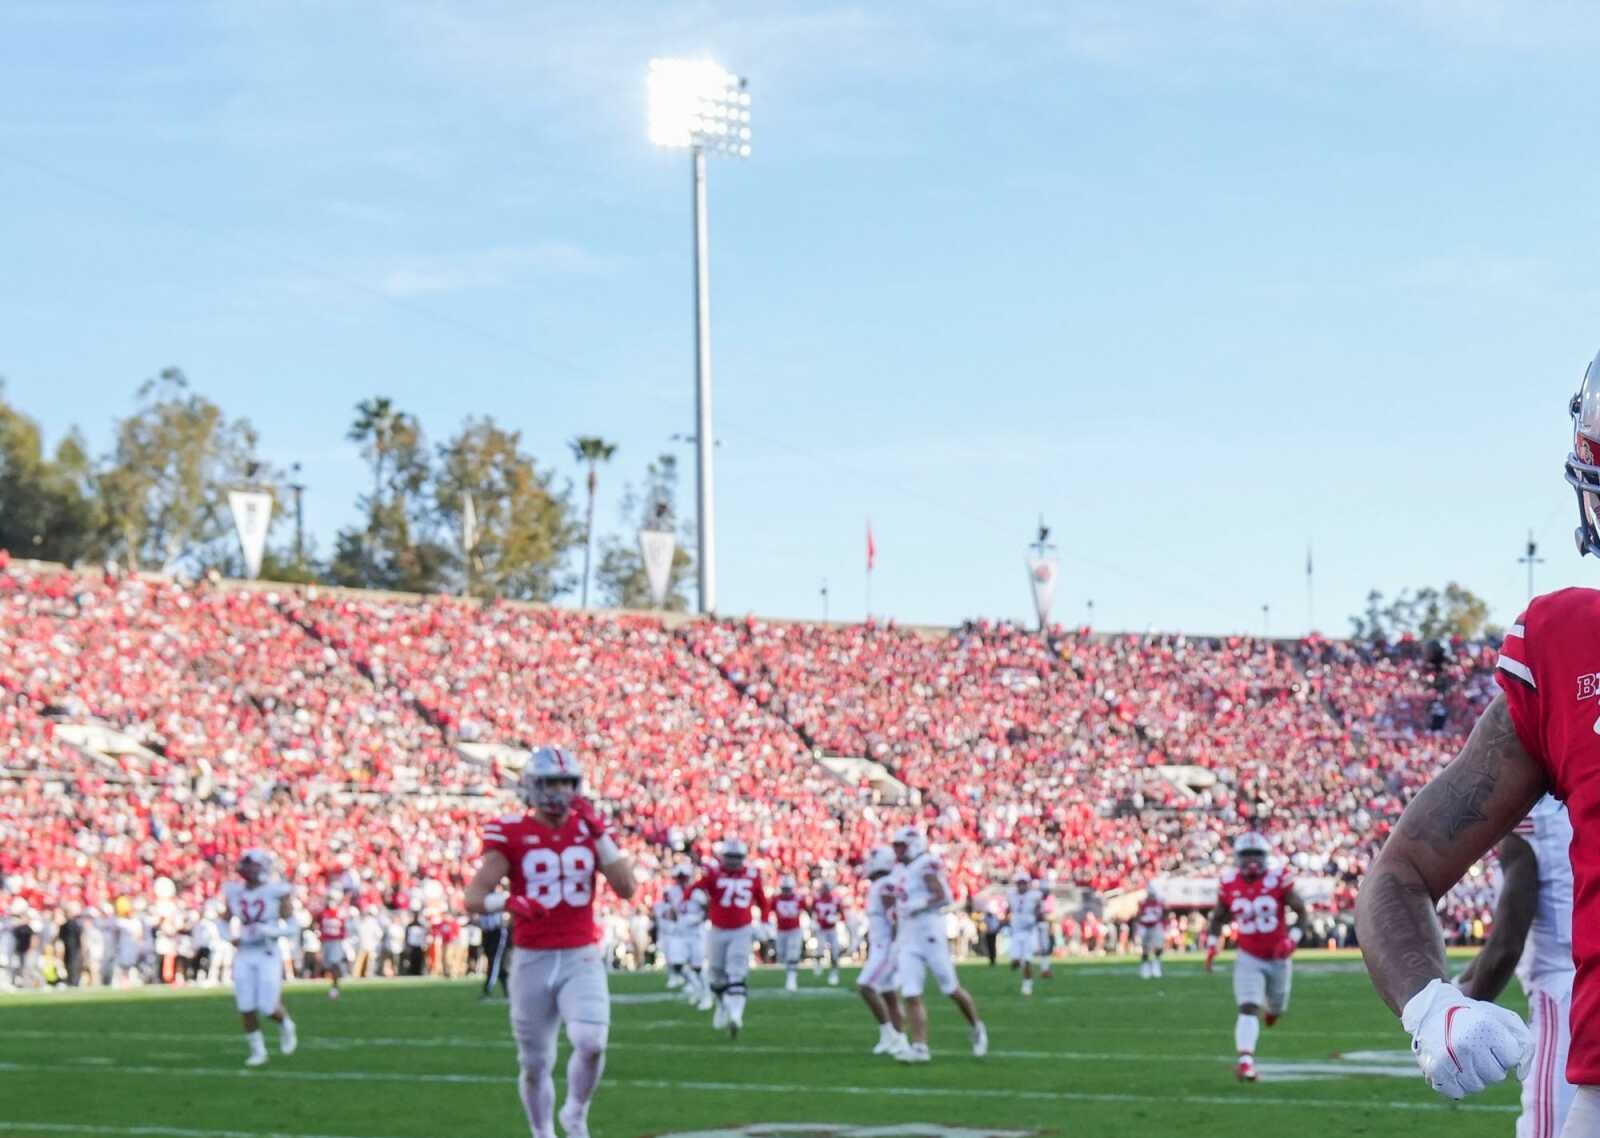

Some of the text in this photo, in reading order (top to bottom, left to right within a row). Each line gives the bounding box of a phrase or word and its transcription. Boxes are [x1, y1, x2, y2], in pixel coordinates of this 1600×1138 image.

[522, 847, 595, 909] 88
[716, 877, 751, 908] 75
[1230, 894, 1280, 934] 28
